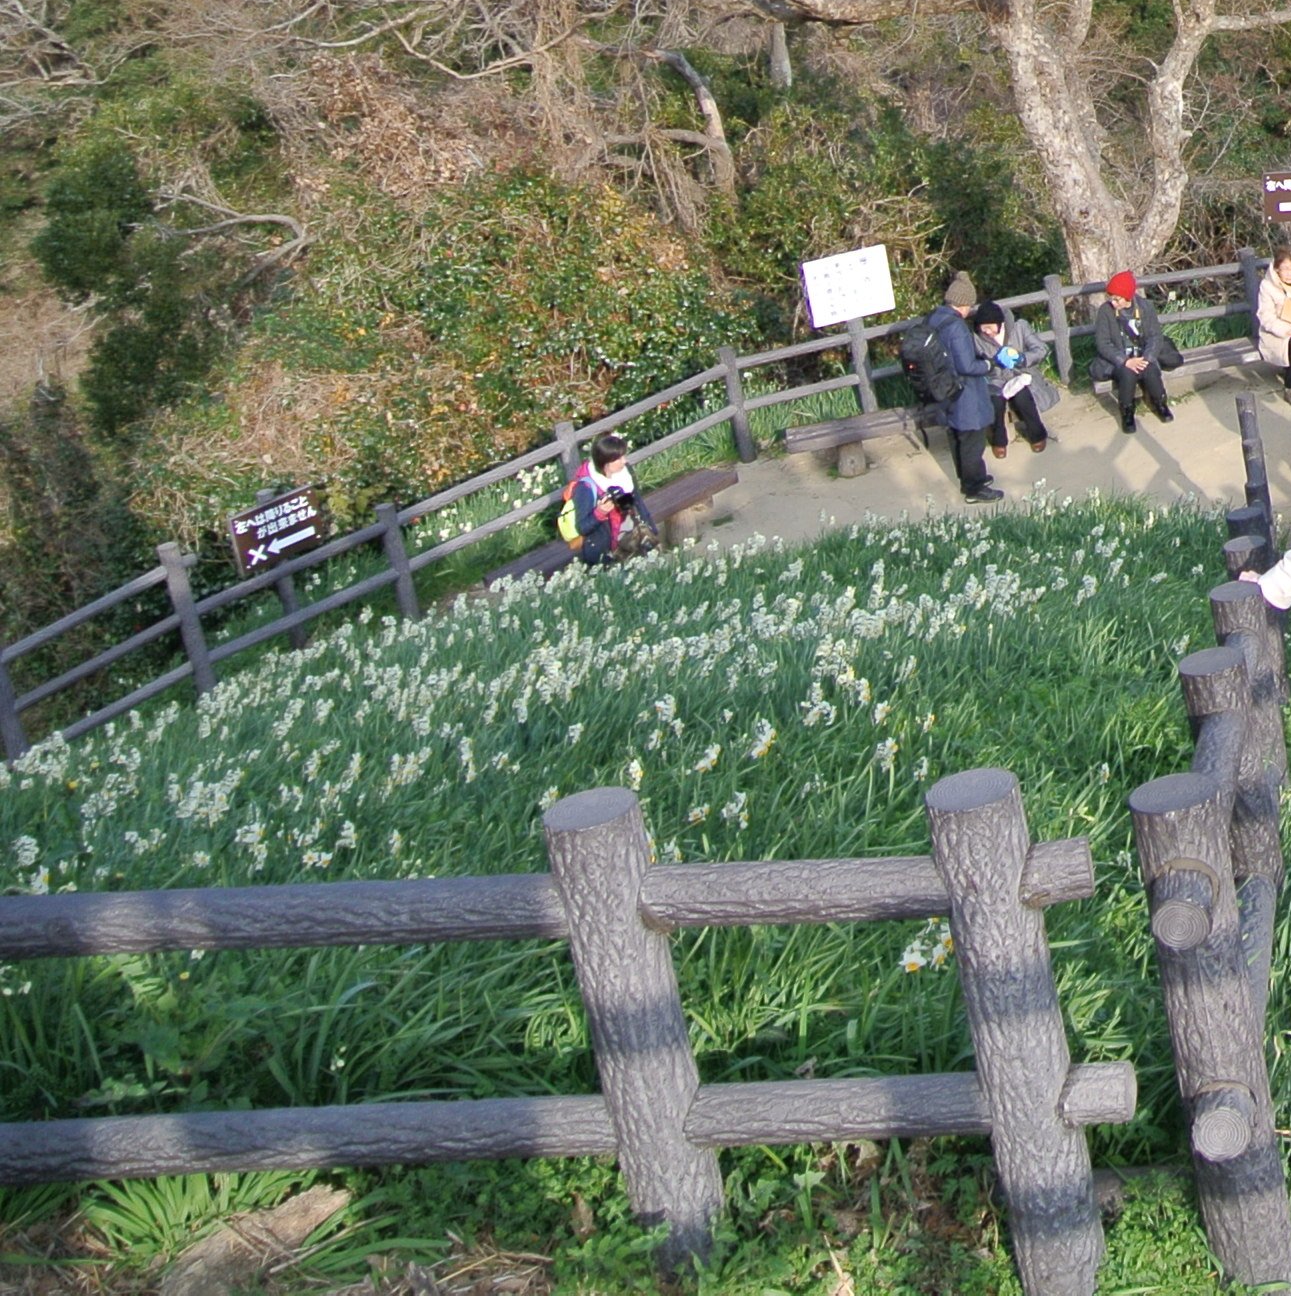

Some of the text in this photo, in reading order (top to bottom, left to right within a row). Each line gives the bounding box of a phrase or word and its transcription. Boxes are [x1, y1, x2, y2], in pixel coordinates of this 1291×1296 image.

[257, 506, 317, 539] が出来ません
